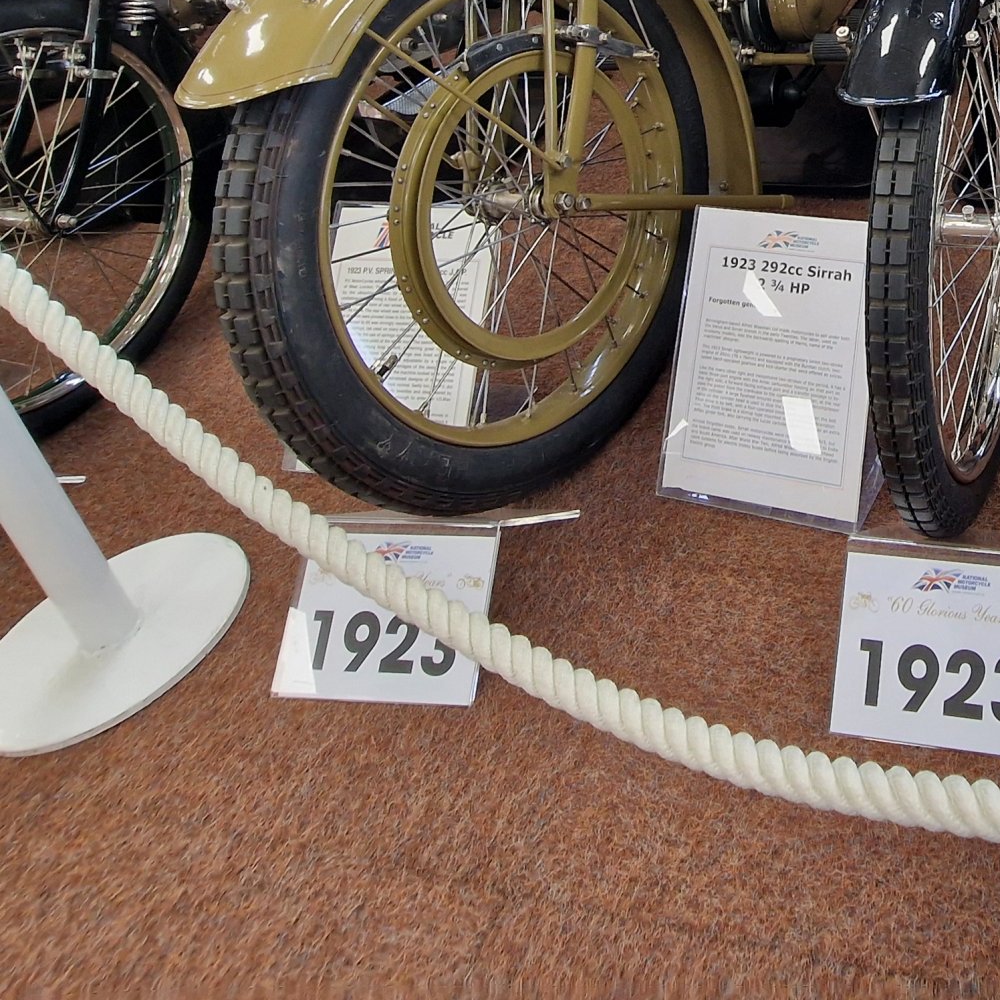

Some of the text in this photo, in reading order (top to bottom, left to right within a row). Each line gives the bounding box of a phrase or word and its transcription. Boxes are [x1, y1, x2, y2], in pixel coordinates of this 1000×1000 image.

[722, 256, 852, 281] 1923 292cc Sirrah
[790, 282, 810, 294] HP
[709, 296, 740, 308] Forgotten
[958, 579, 991, 588] MOTORCYCLE
[917, 600, 967, 621] Glorious
[312, 610, 456, 676] 1923
